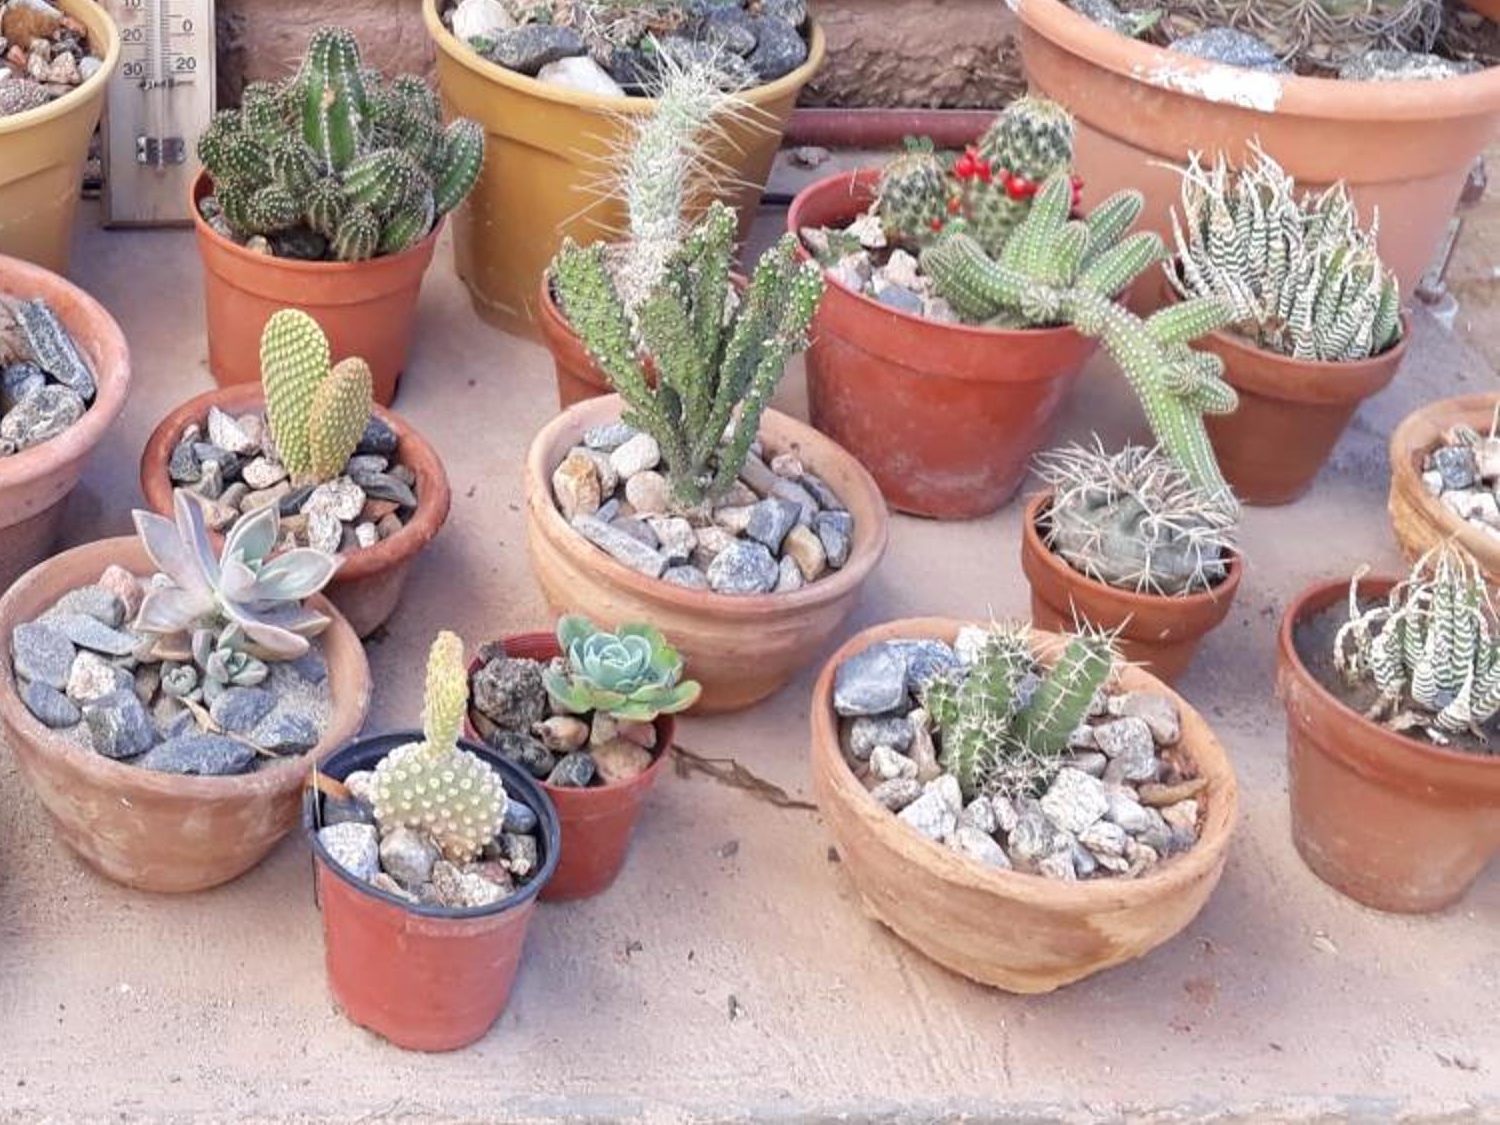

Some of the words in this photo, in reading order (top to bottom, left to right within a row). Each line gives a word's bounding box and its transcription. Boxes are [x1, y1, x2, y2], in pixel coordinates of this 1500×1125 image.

[183, 20, 192, 32] 0
[123, 29, 141, 41] 20
[123, 63, 142, 75] 30
[176, 57, 196, 70] 20
